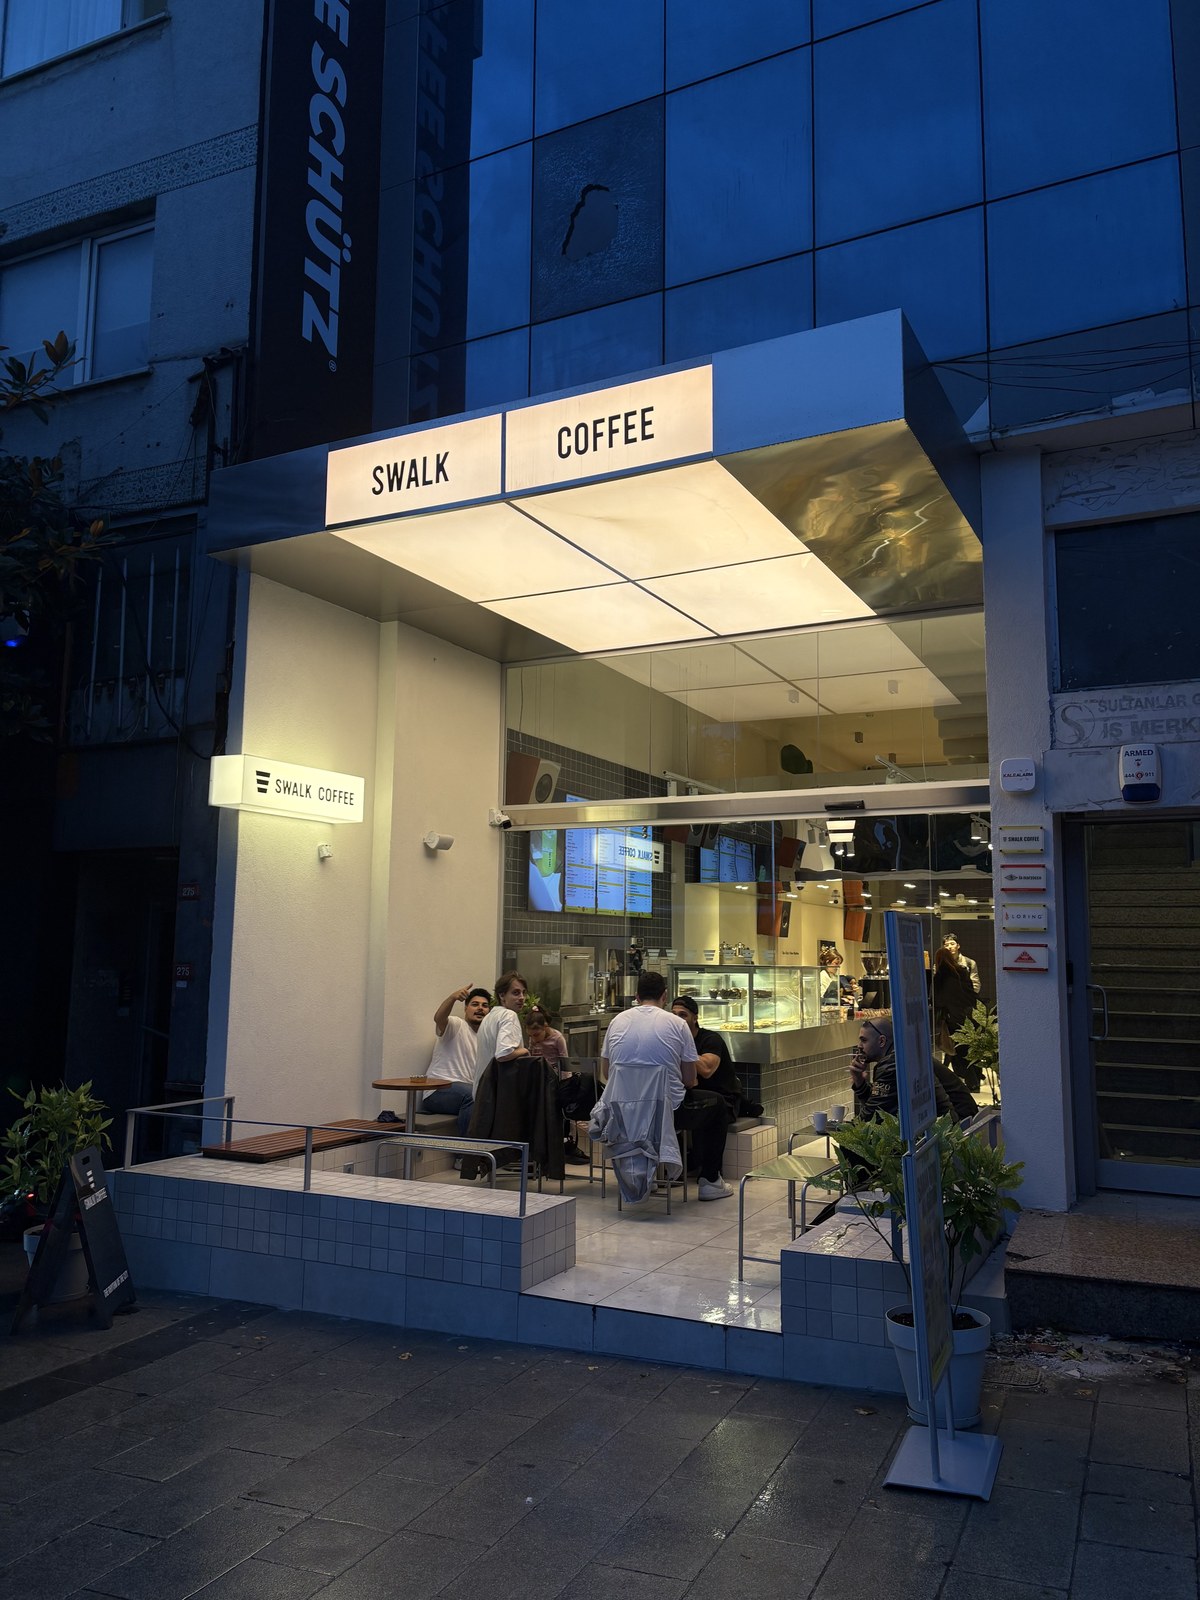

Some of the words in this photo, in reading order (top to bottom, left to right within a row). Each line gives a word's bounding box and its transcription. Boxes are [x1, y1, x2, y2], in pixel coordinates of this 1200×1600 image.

[313, 0, 351, 48] E
[371, 451, 450, 495] SWALK
[557, 405, 655, 459] COFFEE
[1098, 695, 1187, 713] SULTANLAR
[1130, 716, 1200, 737] MERK
[1124, 749, 1154, 757] ARMED
[275, 778, 312, 799] SWALK
[318, 786, 355, 806] COFFEE
[182, 887, 195, 896] 275
[176, 966, 190, 976] 275
